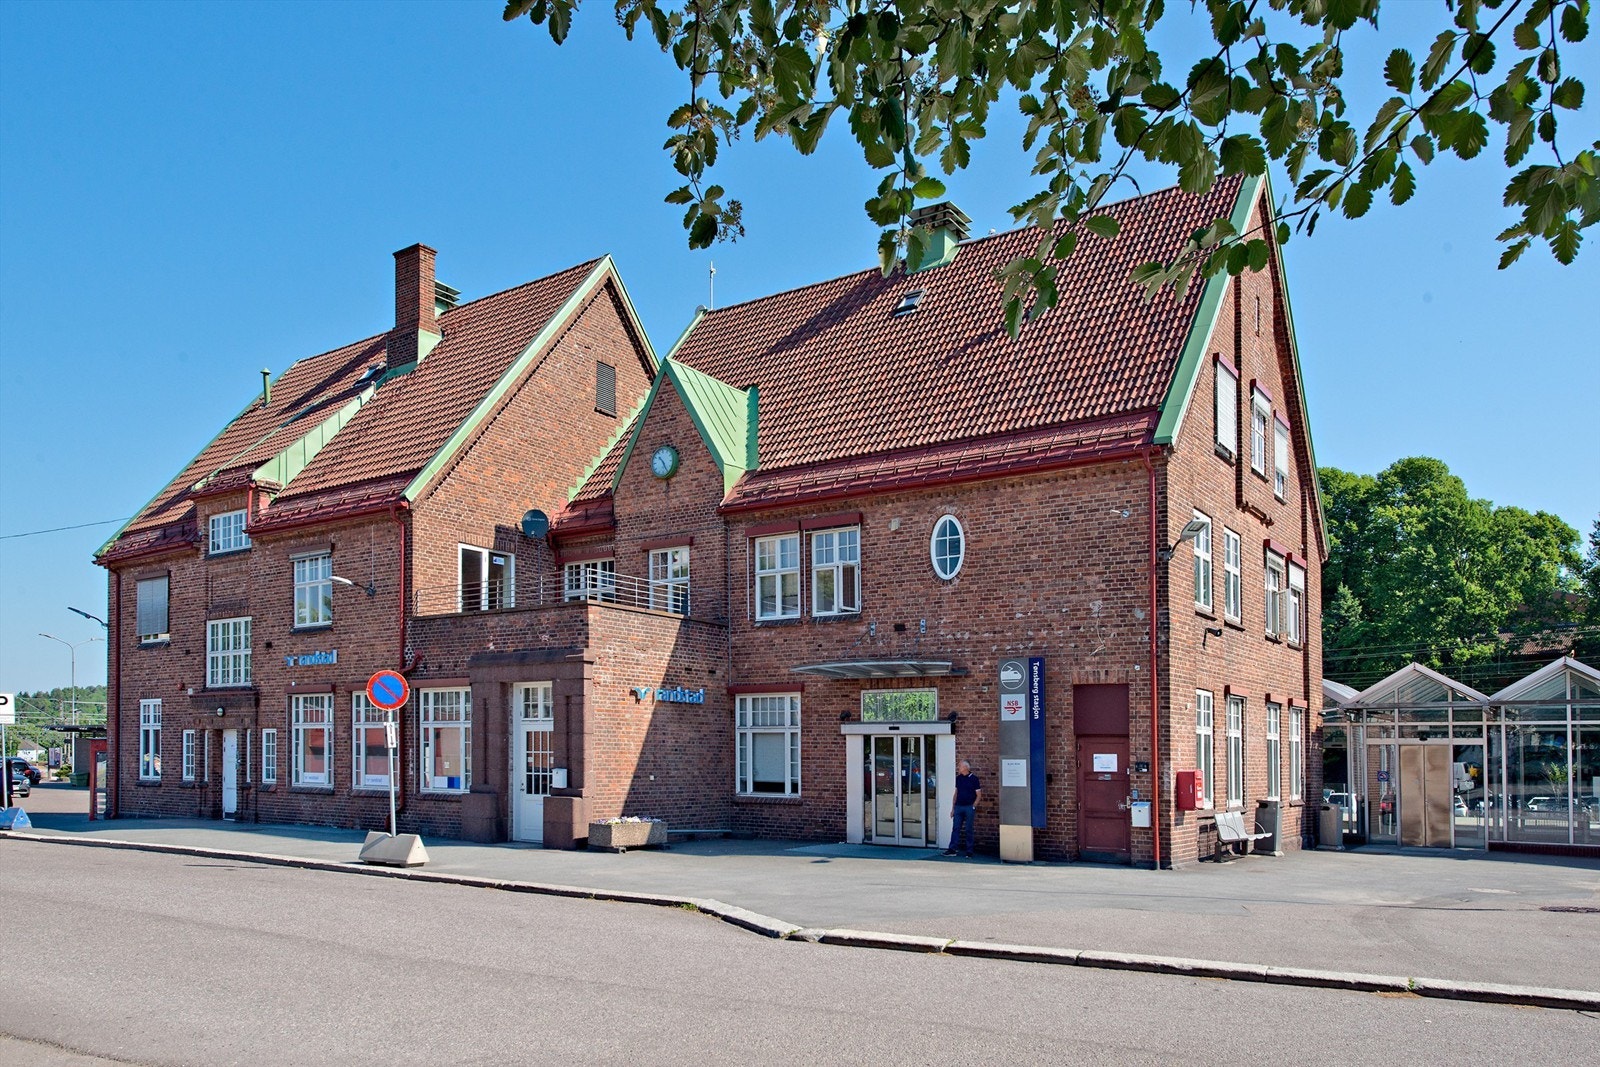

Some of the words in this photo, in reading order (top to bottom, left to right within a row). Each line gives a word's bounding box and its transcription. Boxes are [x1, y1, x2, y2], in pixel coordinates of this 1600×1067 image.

[1031, 661, 1040, 694] Tønsberg
[655, 686, 705, 704] randstad
[1032, 694, 1041, 720] stasjon
